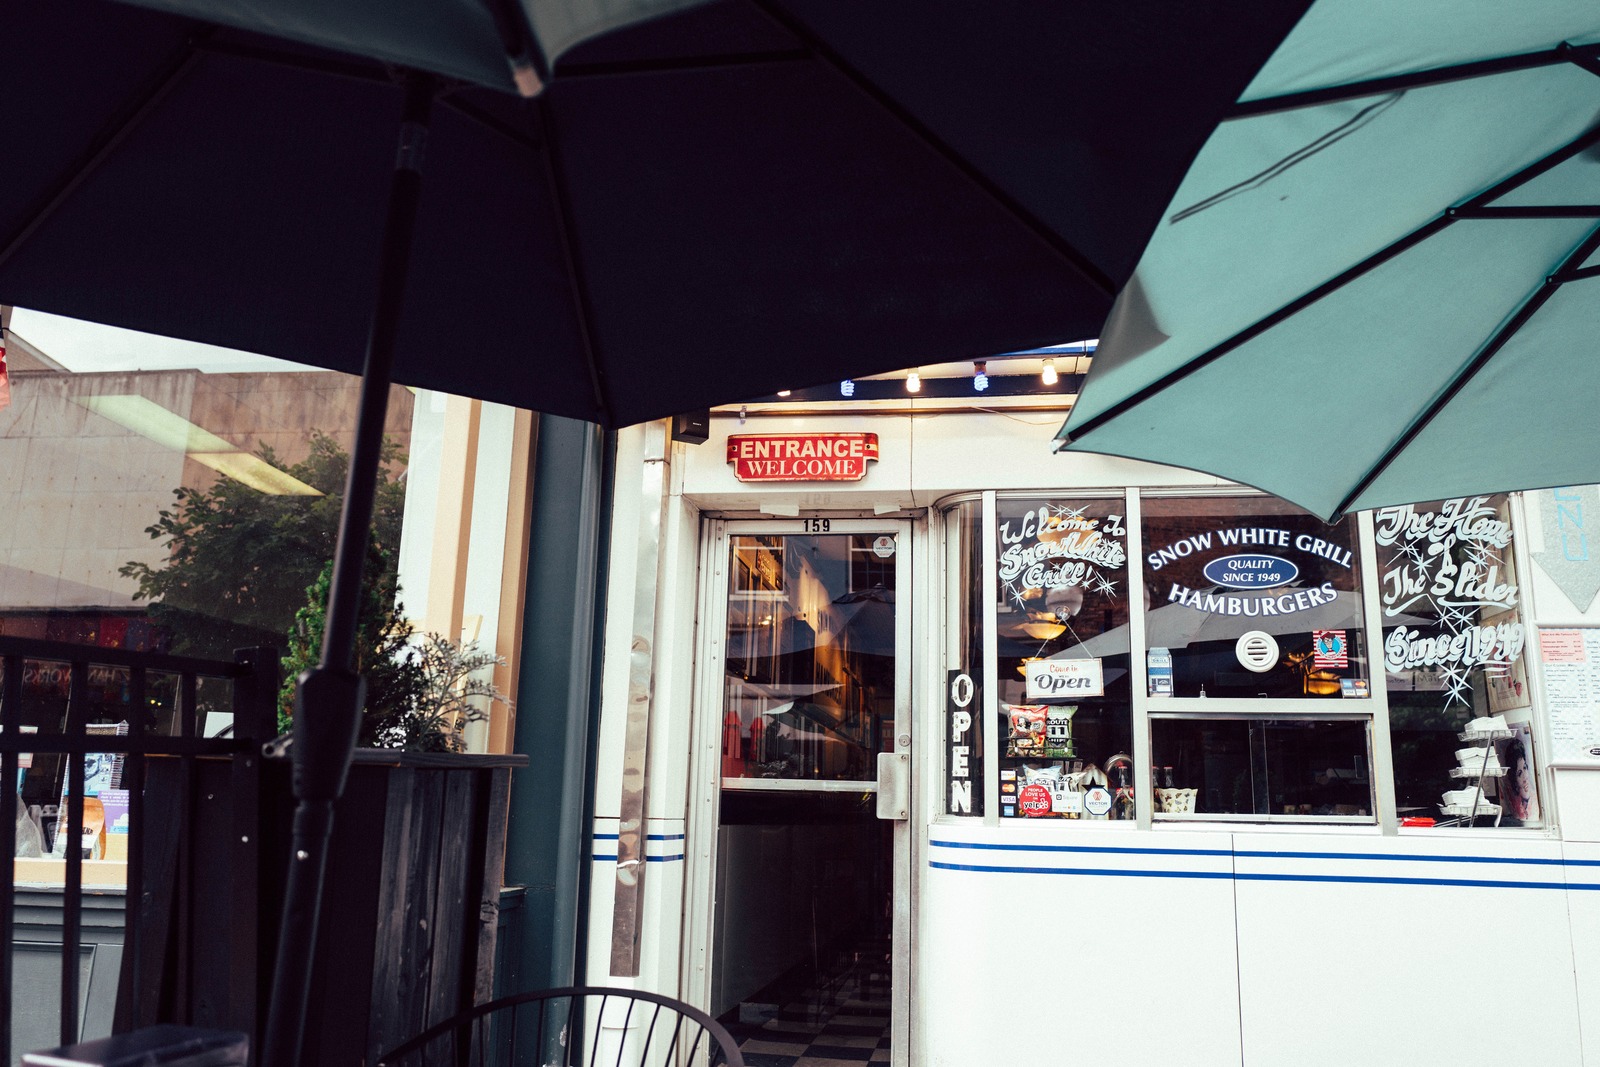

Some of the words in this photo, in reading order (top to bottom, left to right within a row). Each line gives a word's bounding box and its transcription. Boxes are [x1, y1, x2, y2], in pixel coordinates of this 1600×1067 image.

[740, 438, 864, 459] ENTRANCE
[746, 459, 857, 477] WELCOME
[803, 518, 830, 533] 159
[999, 506, 1100, 545] Welcome
[1554, 486, 1589, 561] ENU
[1147, 531, 1213, 571] SNOW
[1217, 527, 1291, 548] WHITE
[1295, 534, 1354, 569] GRILL
[1227, 559, 1275, 571] QUALITY
[1222, 572, 1255, 582] SINCE
[1257, 572, 1281, 582] 1949
[1383, 563, 1427, 606] The
[1430, 560, 1520, 606] Slider
[1167, 582, 1339, 617] HAMBURGERS
[1383, 624, 1466, 674] Since
[1049, 664, 1069, 674] Come
[1034, 673, 1091, 694] Open
[951, 673, 974, 813] OPEN
[1023, 800, 1041, 810] yelp
